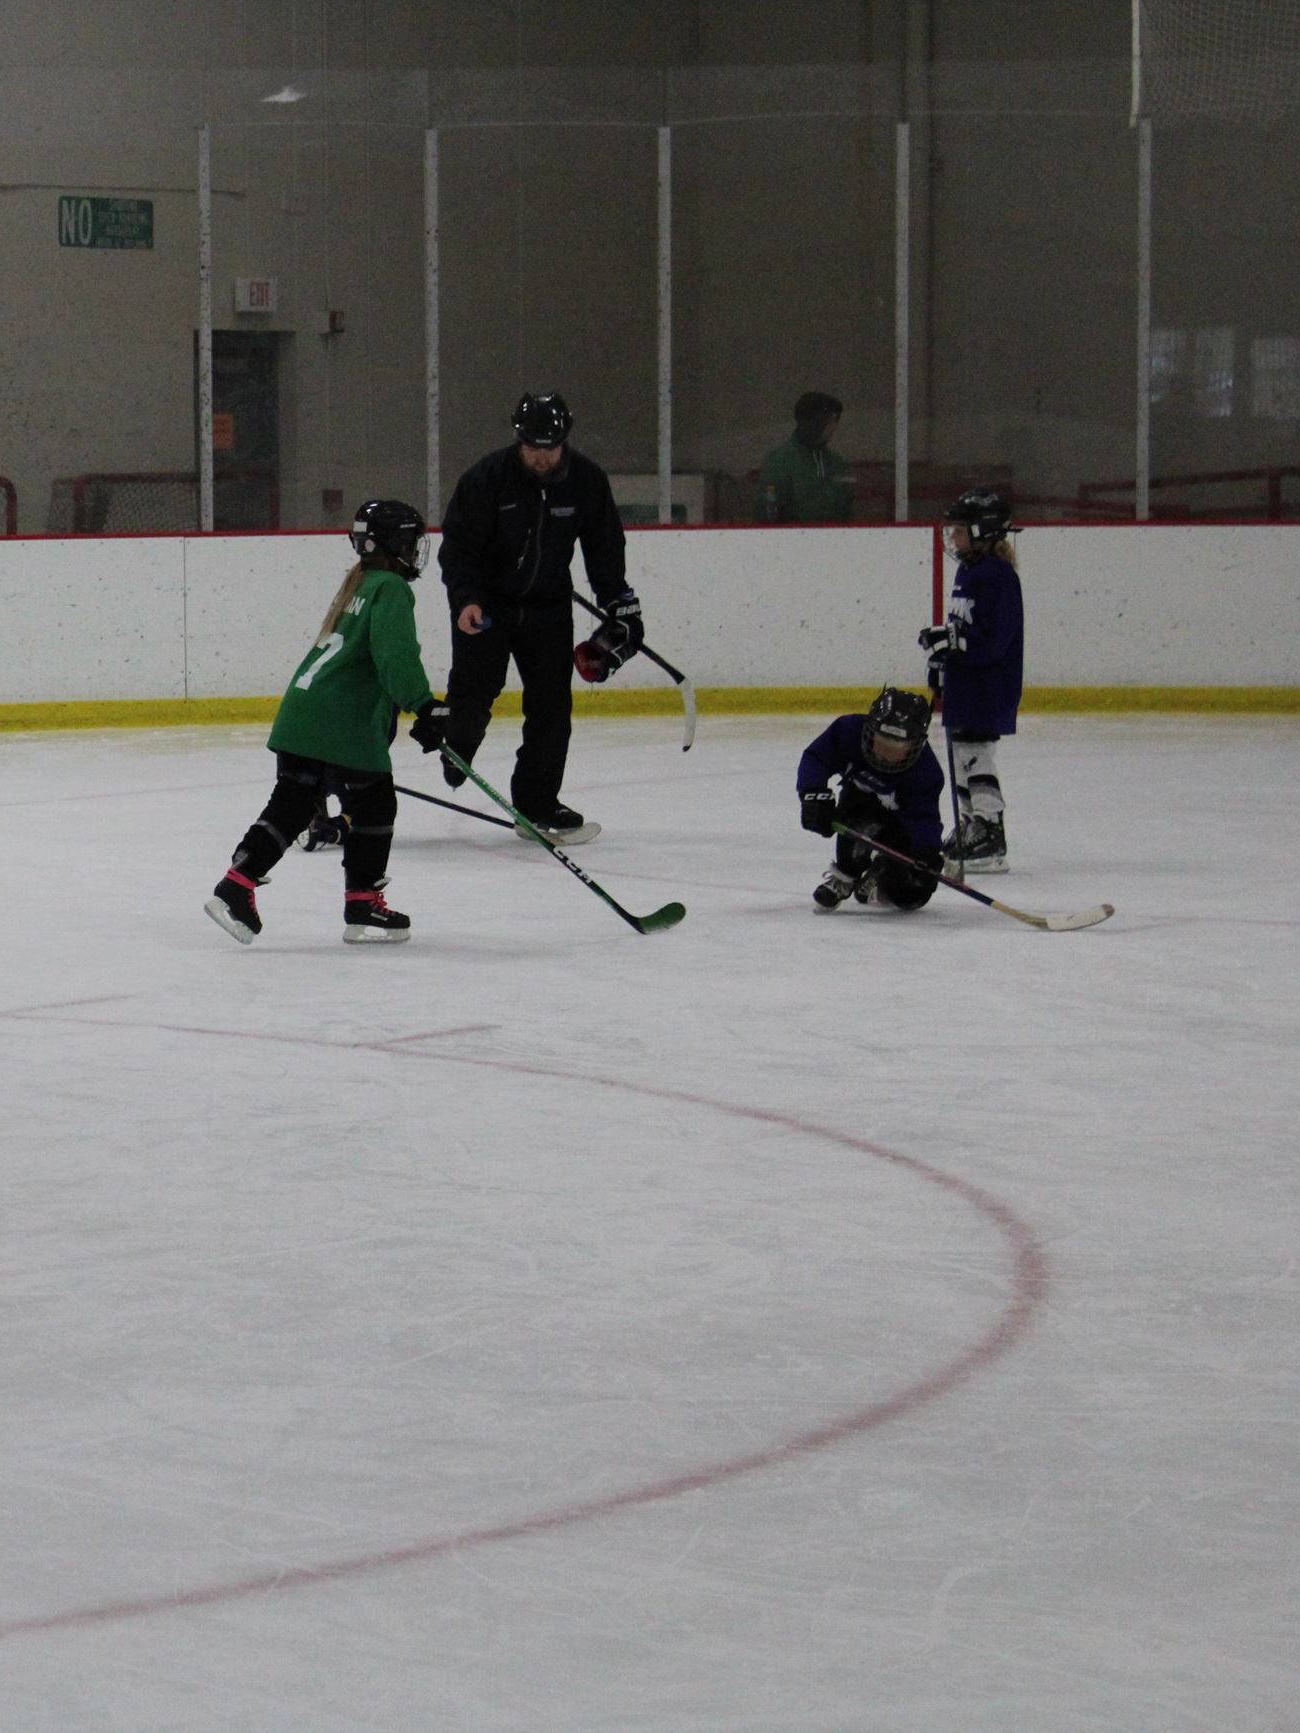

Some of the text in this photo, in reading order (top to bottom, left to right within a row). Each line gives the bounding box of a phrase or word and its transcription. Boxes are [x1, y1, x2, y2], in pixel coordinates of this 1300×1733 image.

[61, 199, 92, 245] NO
[249, 281, 270, 306] EXIT
[294, 632, 345, 690] 7
[552, 846, 594, 884] CCM
